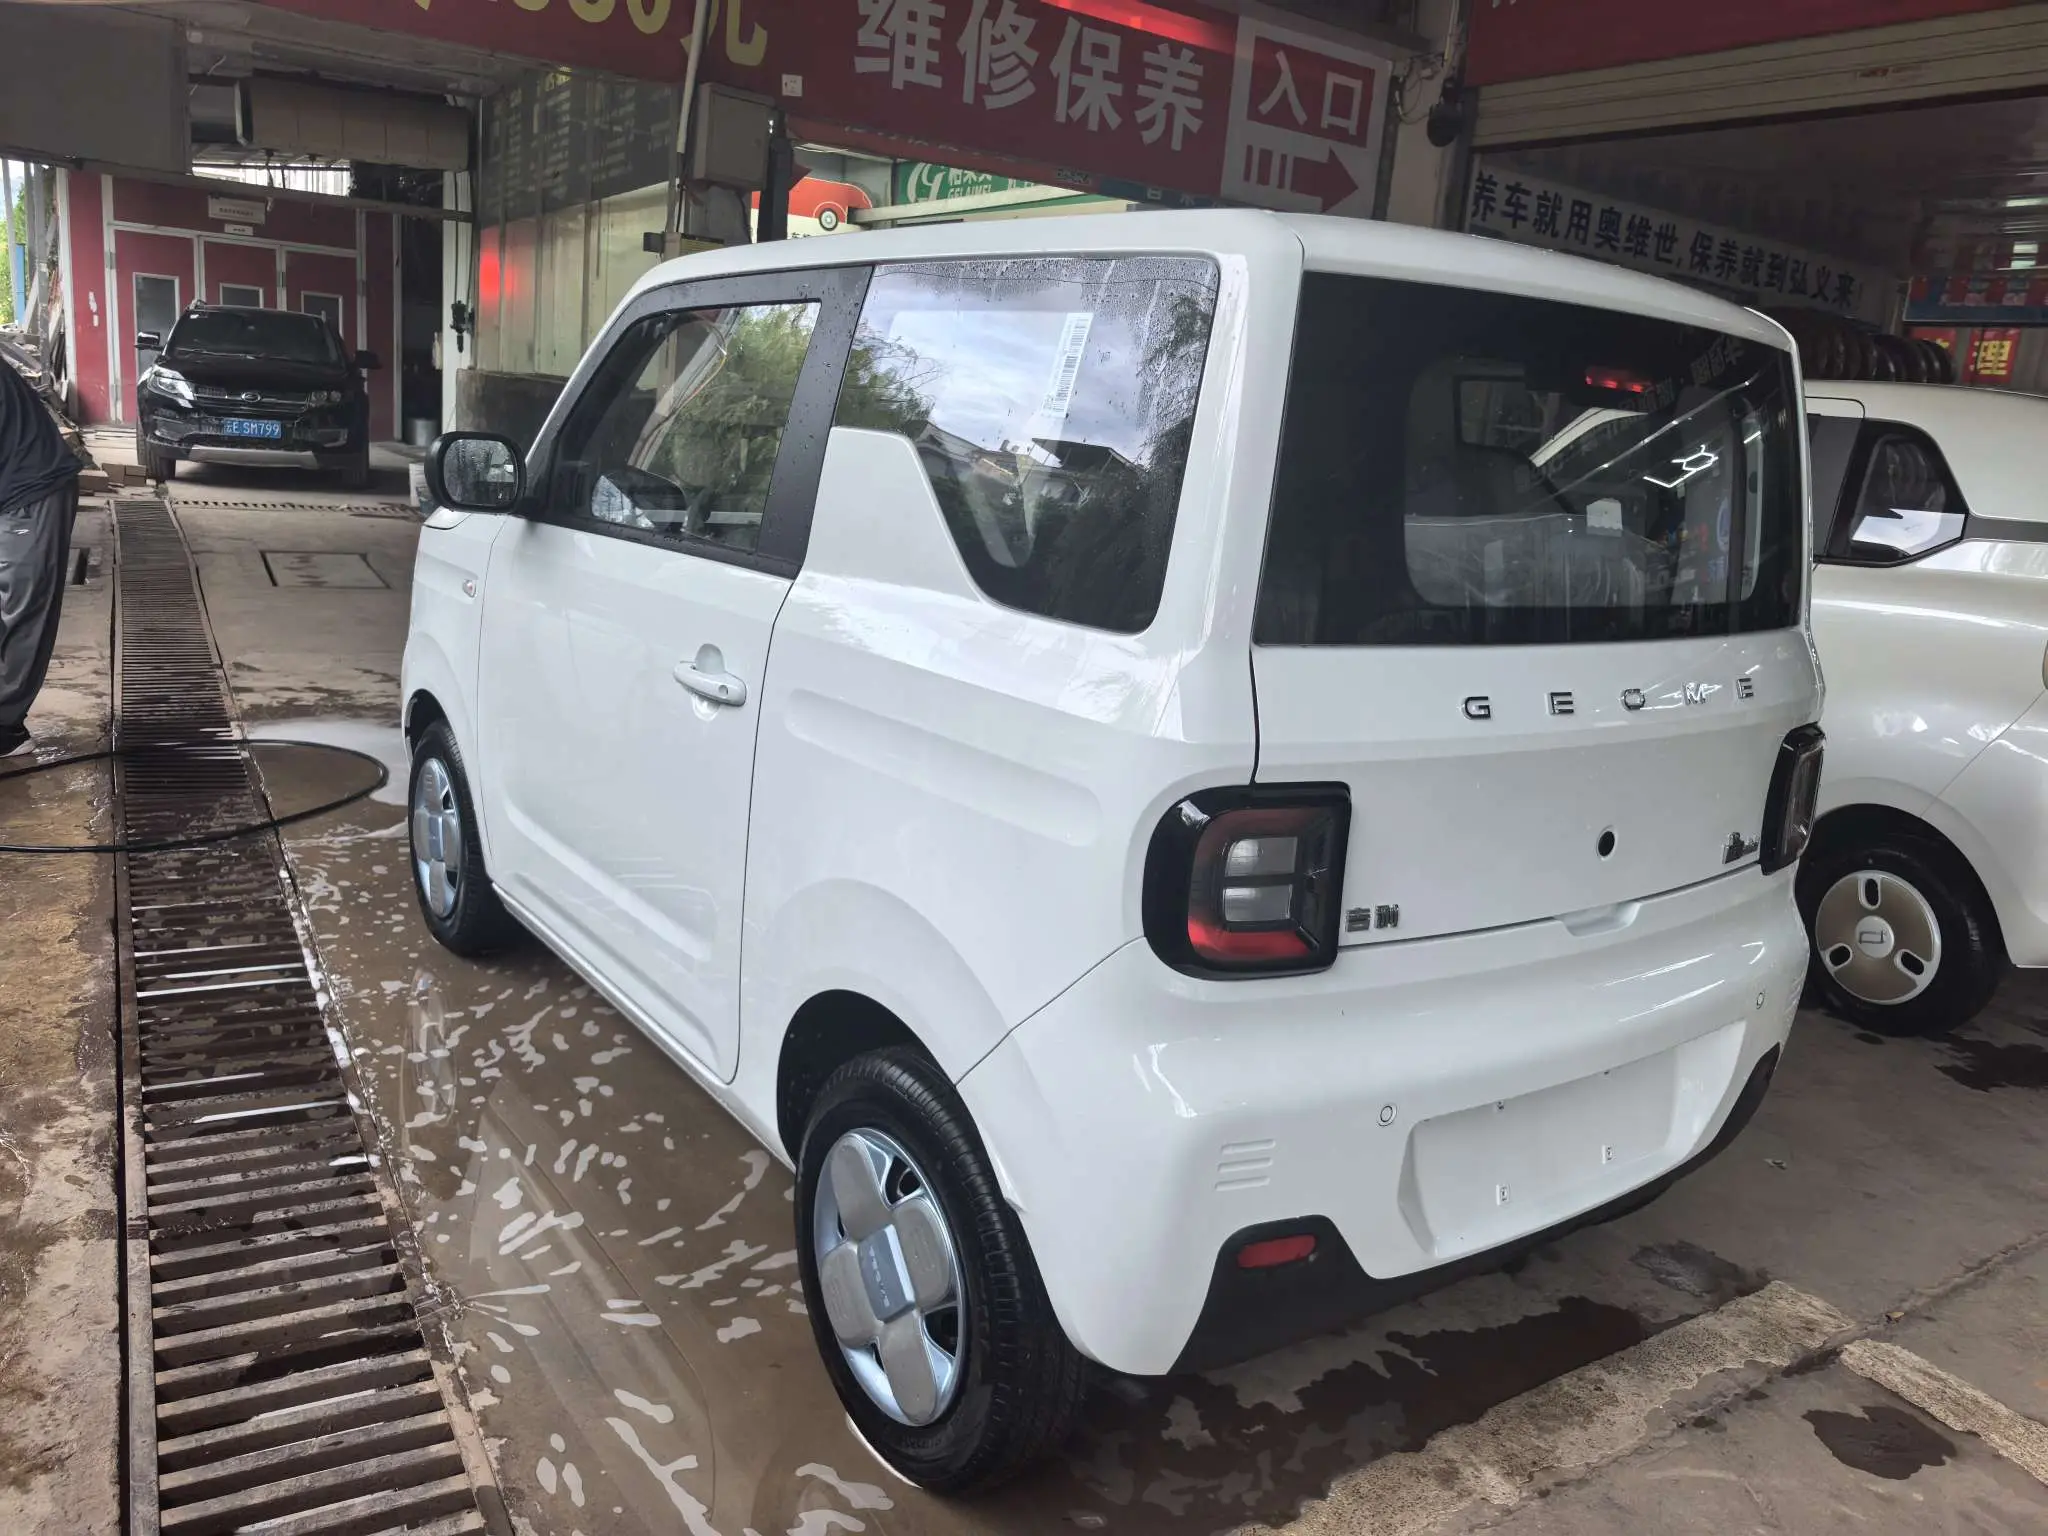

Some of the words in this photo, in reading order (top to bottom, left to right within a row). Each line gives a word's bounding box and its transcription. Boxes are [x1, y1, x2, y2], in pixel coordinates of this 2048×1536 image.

[853, 0, 1204, 151] 维修保养
[1258, 49, 1363, 136] 入口
[1461, 677, 1754, 719] GEOME
